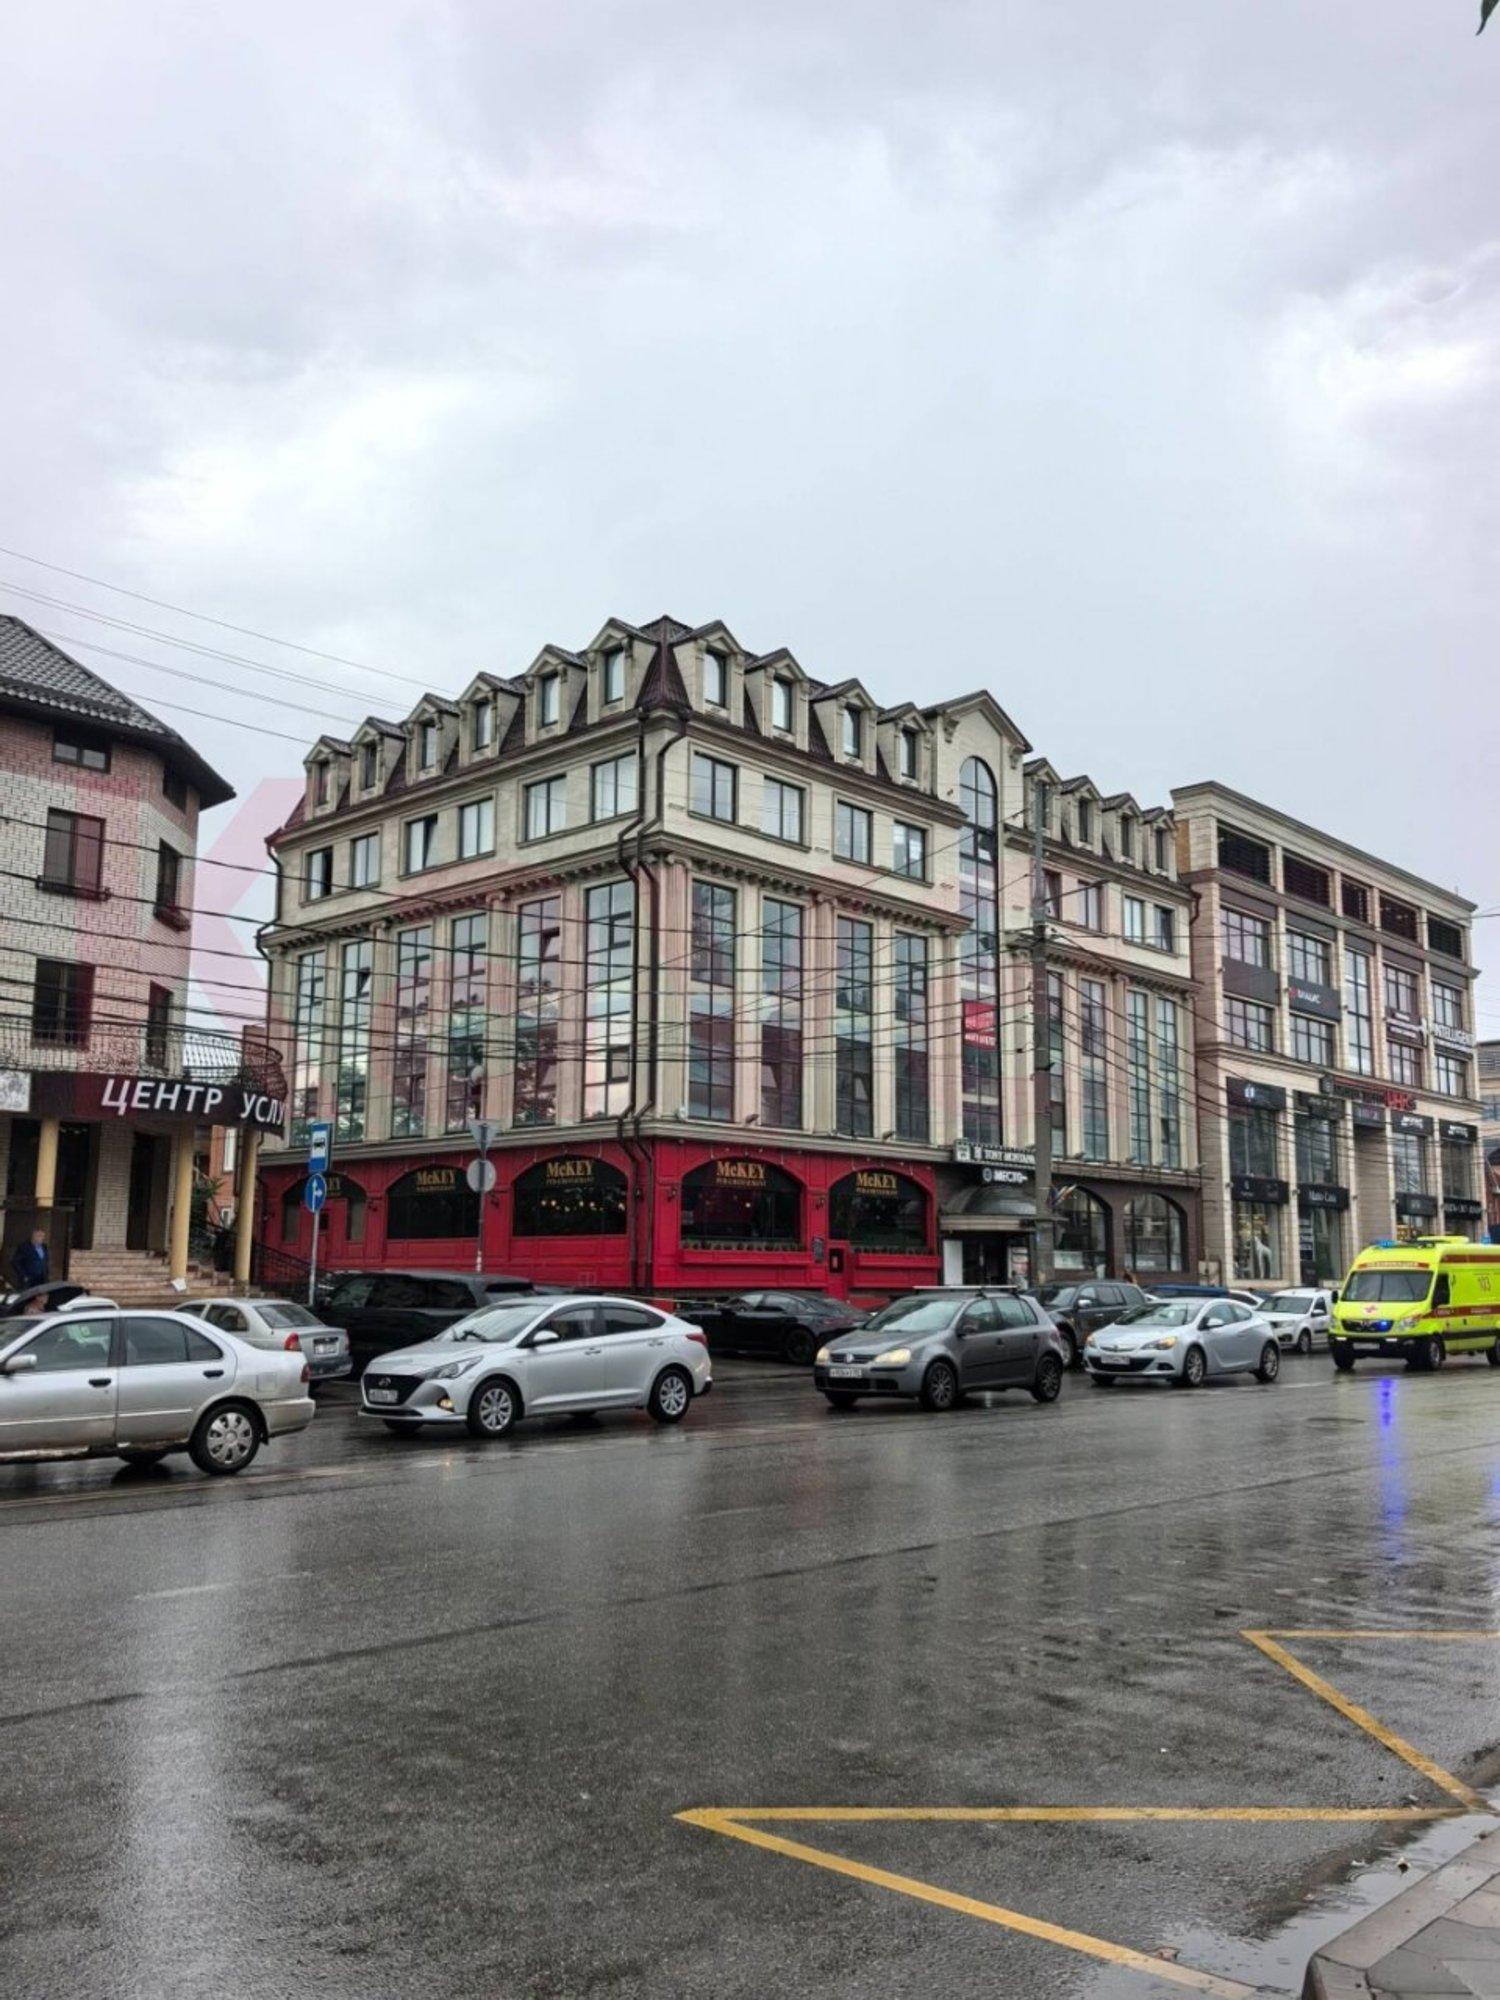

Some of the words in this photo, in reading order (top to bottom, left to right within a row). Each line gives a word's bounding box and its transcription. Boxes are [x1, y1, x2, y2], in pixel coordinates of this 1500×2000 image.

[101, 1078, 223, 1116] ЦЕНТР
[416, 1169, 456, 1185] McKEY
[546, 1161, 592, 1177] McKEY
[716, 1161, 765, 1178] McKEY
[856, 1172, 897, 1189] McKEY
